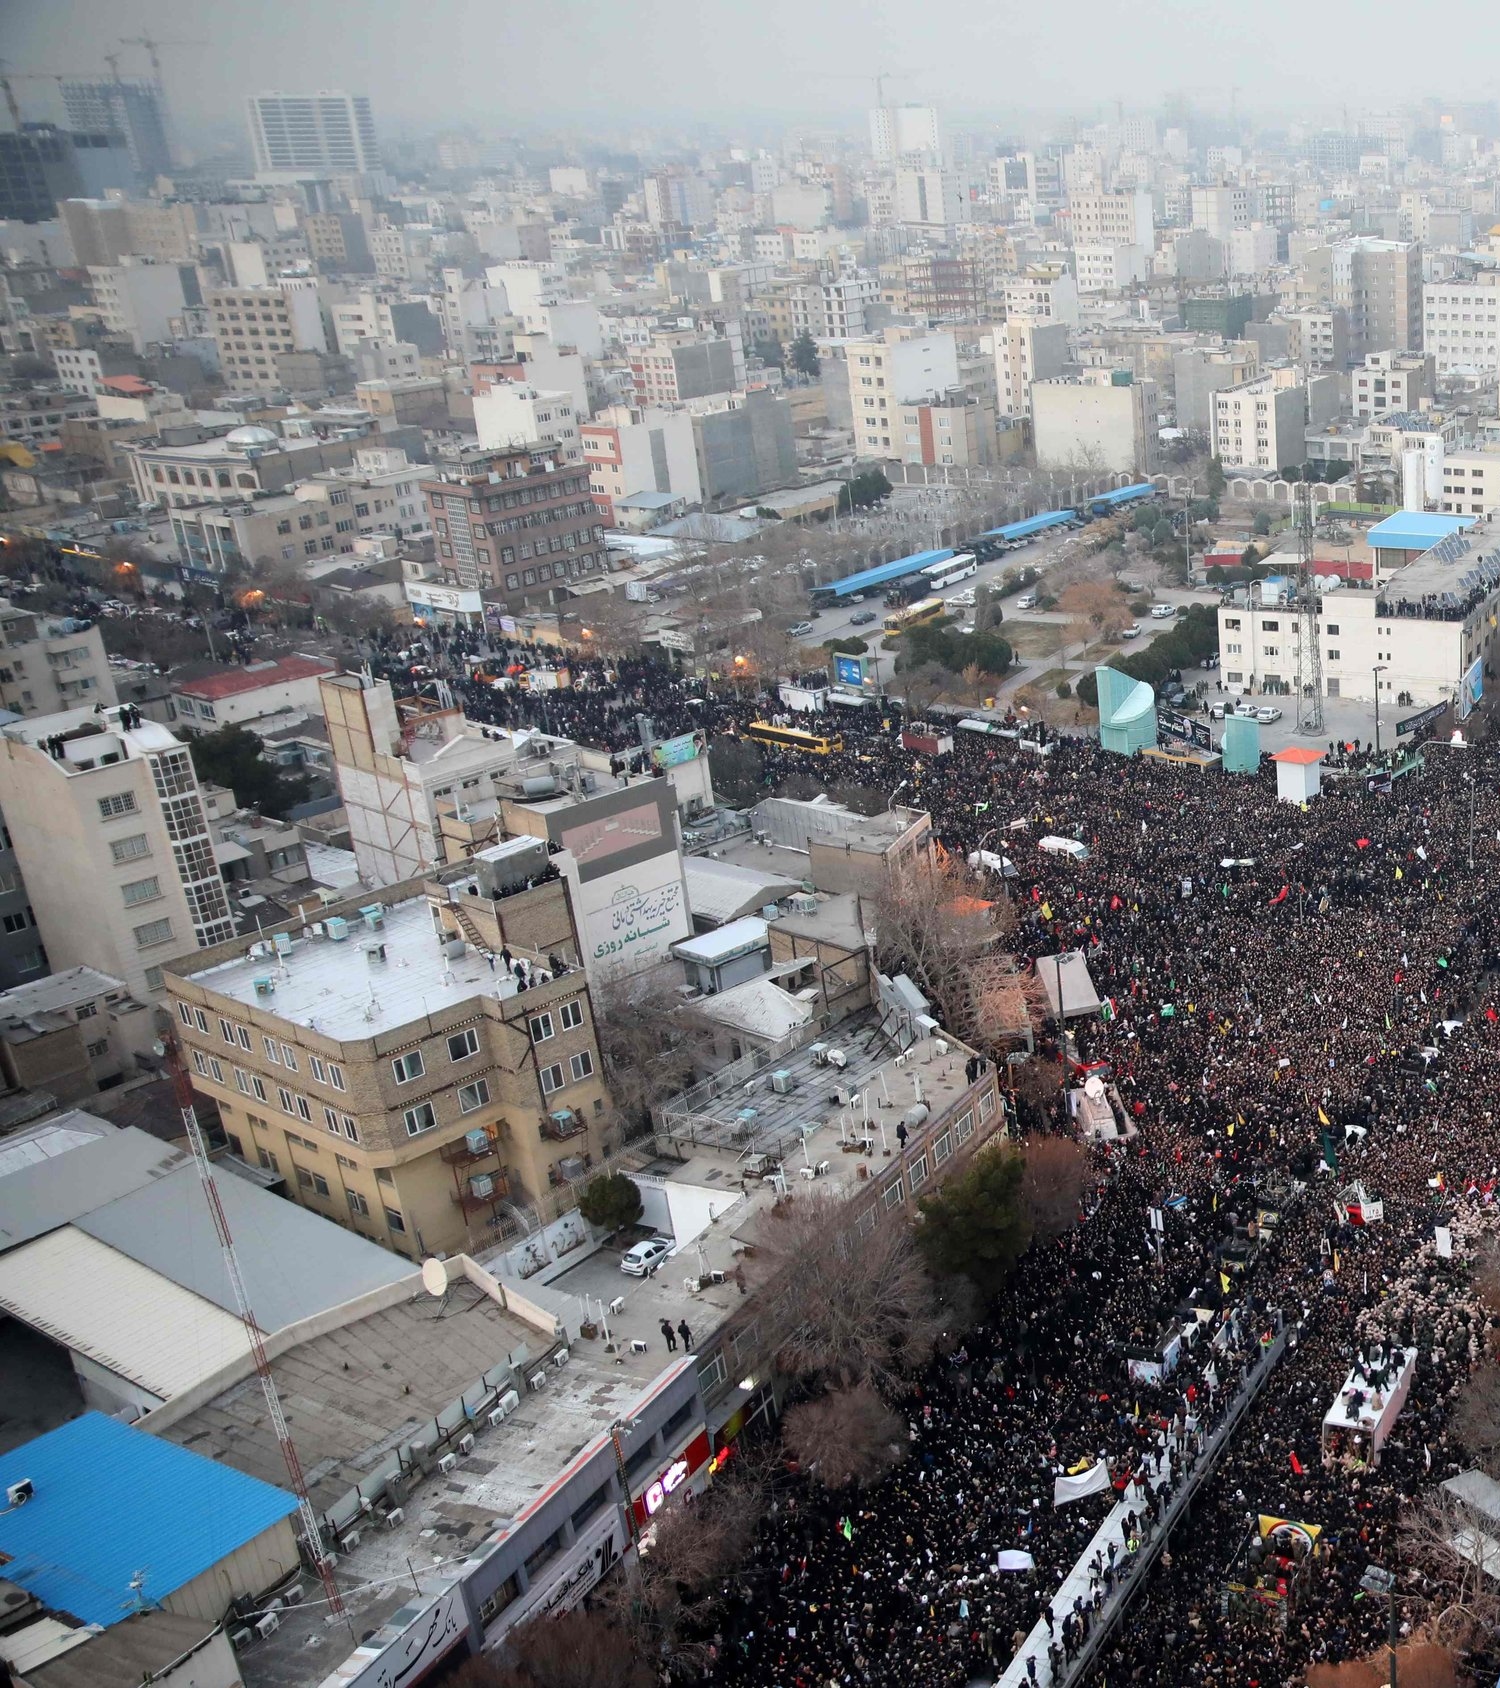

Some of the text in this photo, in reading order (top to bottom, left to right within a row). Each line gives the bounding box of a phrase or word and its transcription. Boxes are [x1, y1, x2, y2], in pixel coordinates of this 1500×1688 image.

[665, 886, 679, 911] مجتمع
[593, 916, 671, 959] شبانه روزی
[432, 1597, 458, 1648] بانک
